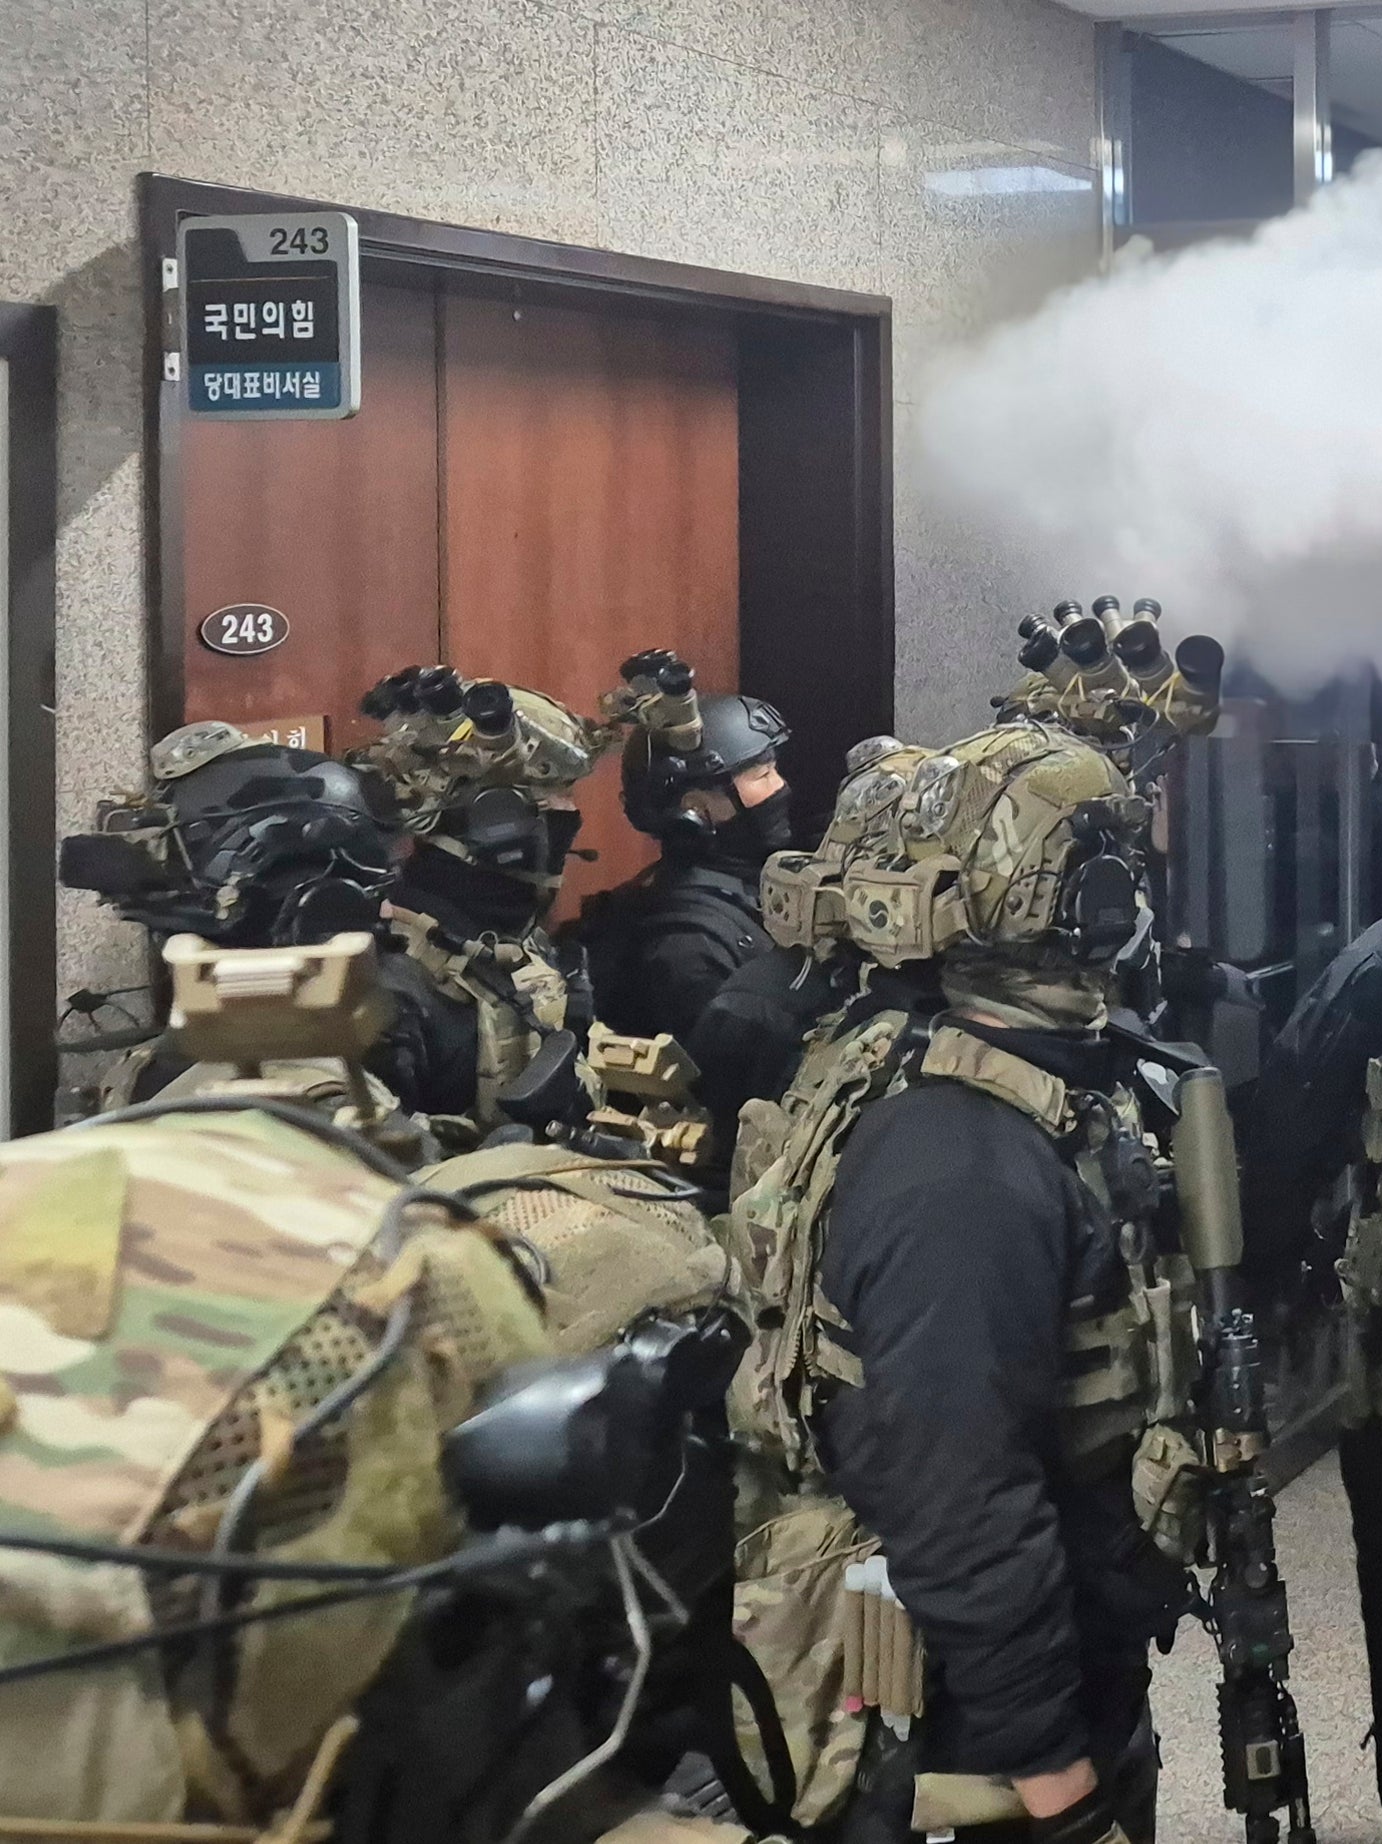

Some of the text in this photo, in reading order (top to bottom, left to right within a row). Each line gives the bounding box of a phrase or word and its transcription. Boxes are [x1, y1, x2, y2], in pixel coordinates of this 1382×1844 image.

[269, 227, 329, 255] 243
[204, 300, 314, 340] 국민의힘
[204, 371, 321, 401] 당대표비서실
[221, 613, 273, 644] 243
